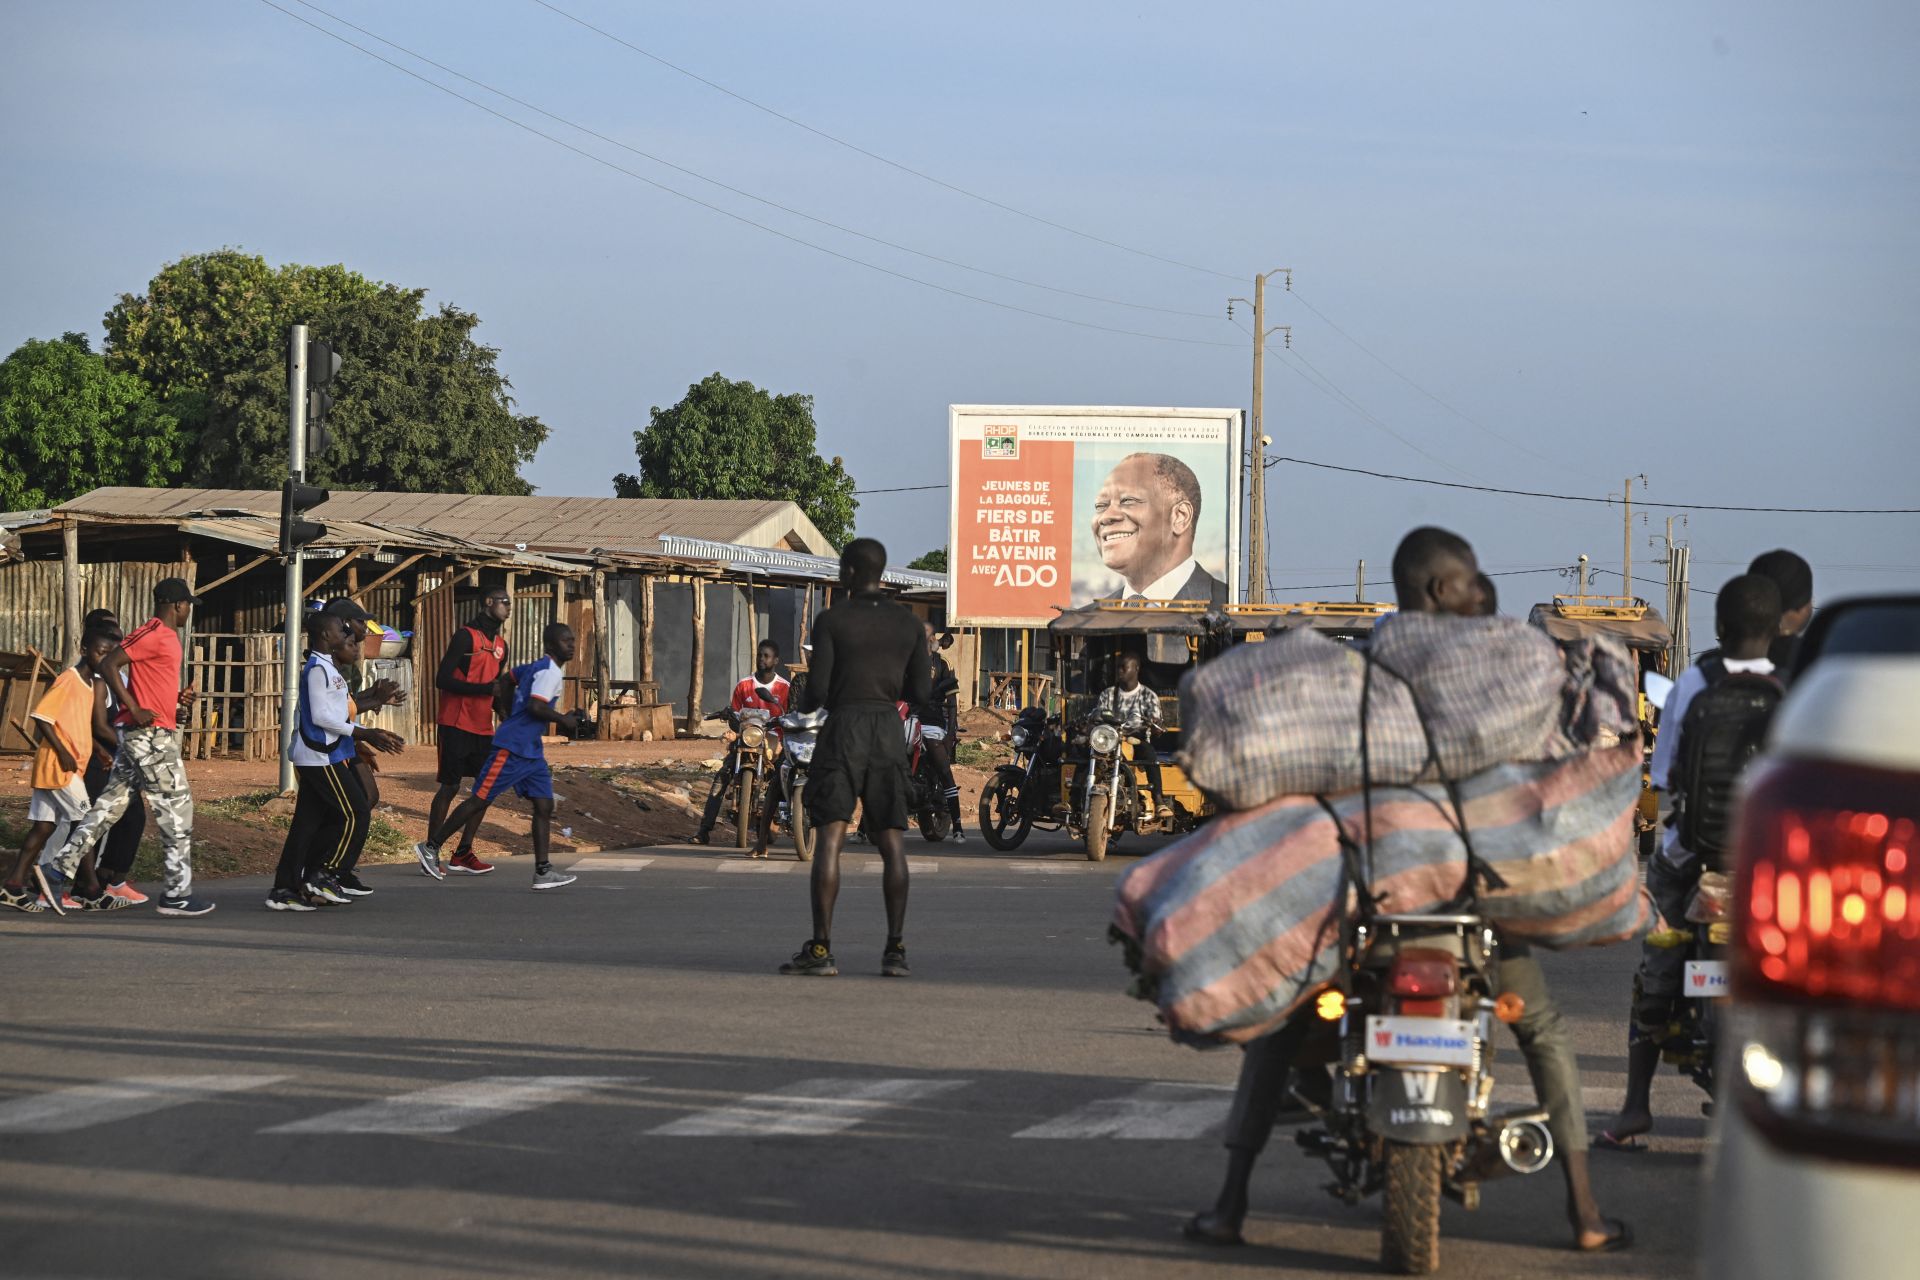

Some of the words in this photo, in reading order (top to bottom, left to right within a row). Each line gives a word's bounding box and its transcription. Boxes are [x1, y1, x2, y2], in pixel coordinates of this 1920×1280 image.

[982, 481, 1031, 491] JEUNES
[1034, 481, 1050, 491] DE
[980, 496, 993, 504] LA
[996, 493, 1051, 506] BAGOUÉ,
[977, 509, 1027, 524] FIERS
[1031, 510, 1054, 524] DE
[989, 526, 1041, 543] BÂTIR
[972, 545, 1057, 560] L'AVENIR
[972, 565, 997, 574] AVEC
[994, 564, 1058, 587] ADO
